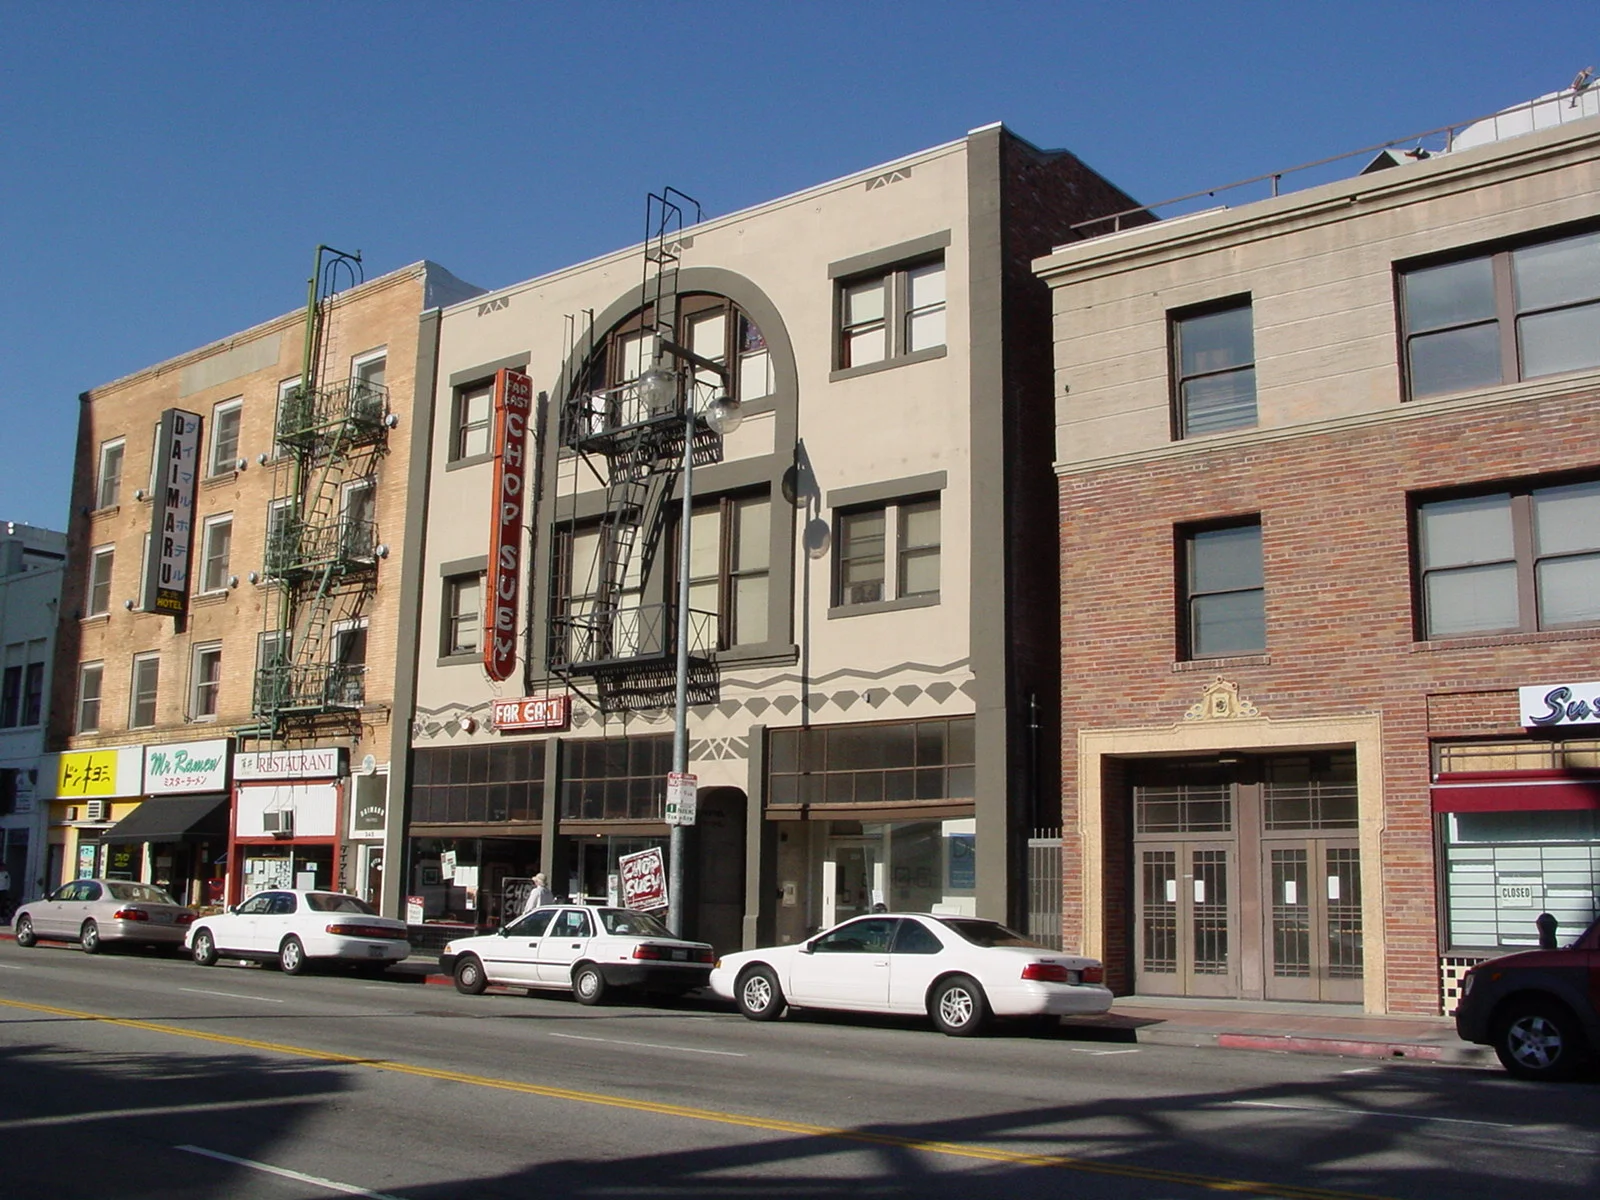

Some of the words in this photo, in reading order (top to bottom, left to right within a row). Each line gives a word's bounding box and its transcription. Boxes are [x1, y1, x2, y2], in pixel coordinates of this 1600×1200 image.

[503, 413, 523, 525] CHOP
[162, 415, 185, 584] DAIMARU
[173, 421, 197, 581] ダイマルホテル
[156, 597, 183, 610] HOTEL
[496, 547, 517, 662] SUEY
[496, 704, 519, 722] FAR
[524, 701, 557, 721] EAST
[174, 750, 222, 774] Ramen
[259, 754, 333, 773] RESTAURANT
[506, 883, 533, 899] CHO
[1502, 888, 1530, 898] CLOSED
